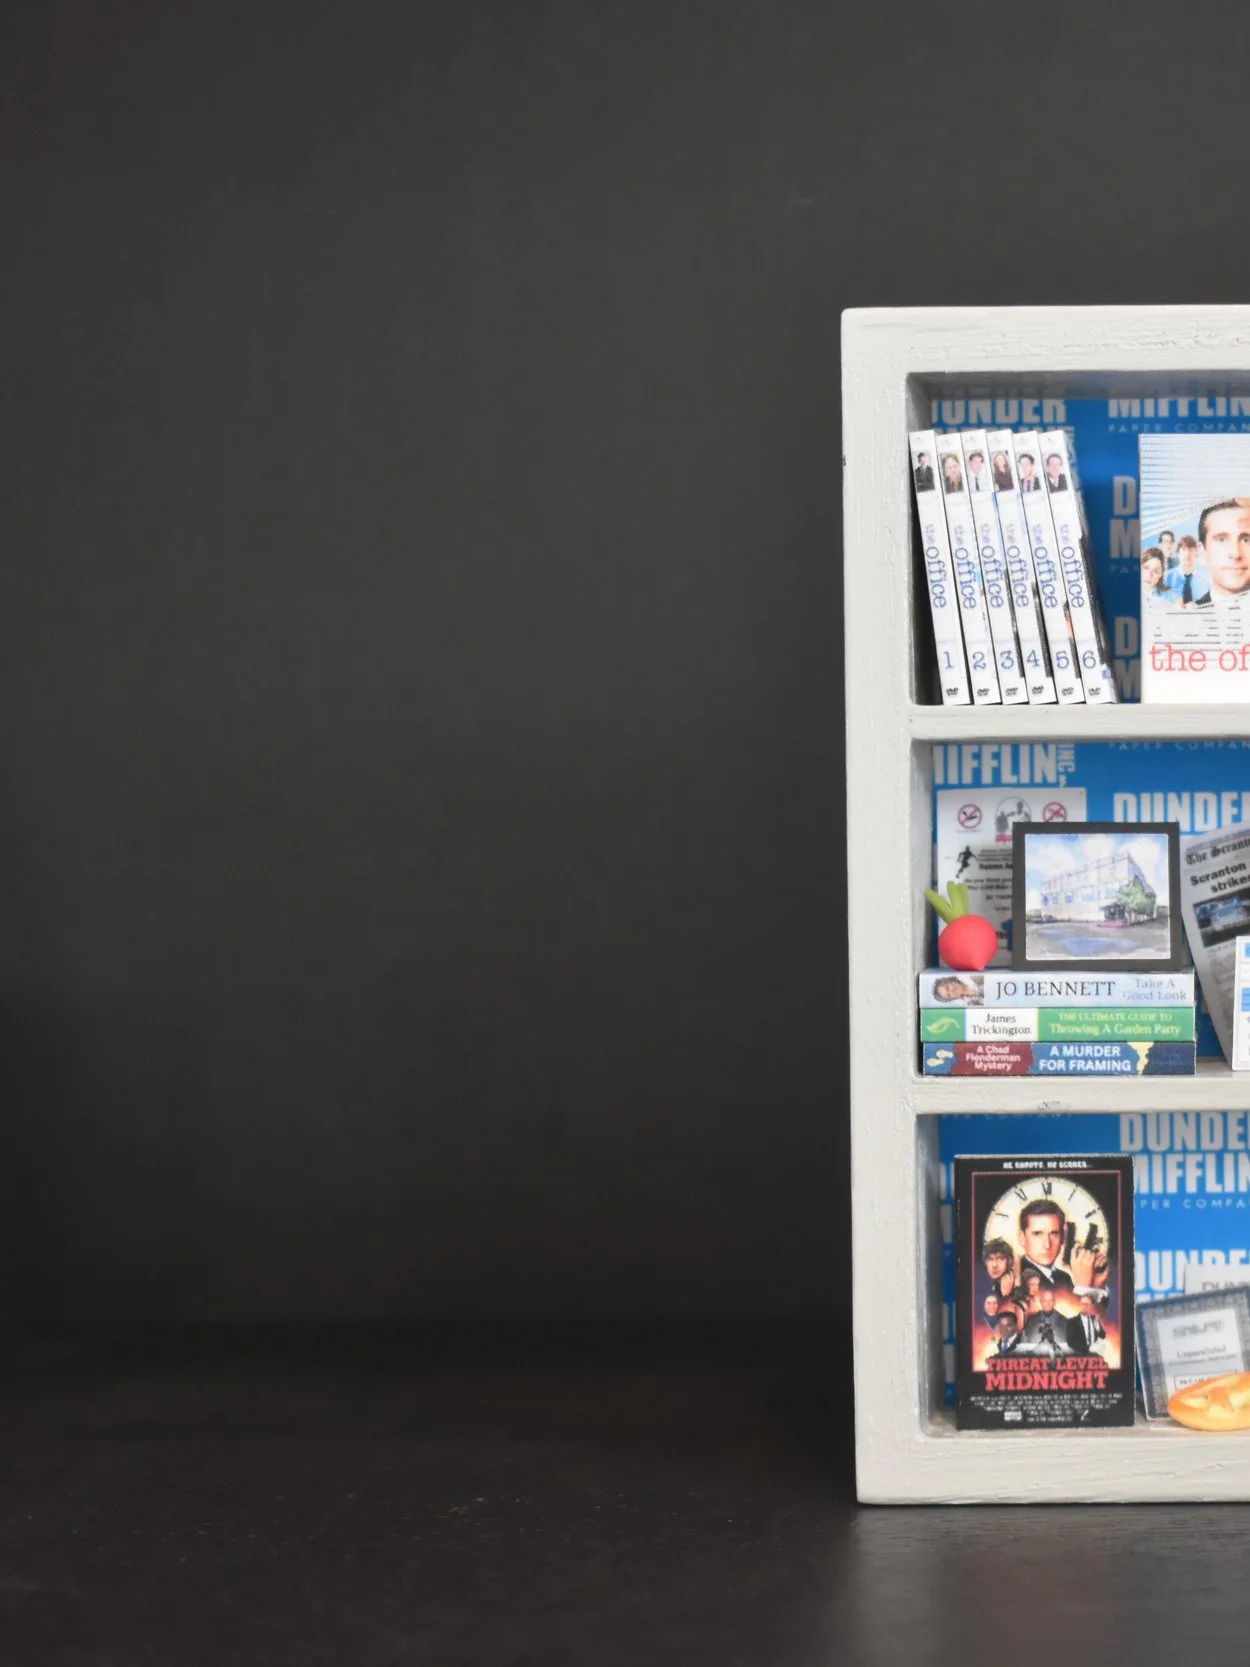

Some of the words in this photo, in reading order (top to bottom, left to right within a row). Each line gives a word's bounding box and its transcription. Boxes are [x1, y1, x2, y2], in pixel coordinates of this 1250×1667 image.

[1108, 423, 1162, 433] PAPER
[926, 546, 947, 609] office
[955, 547, 977, 609] office
[981, 545, 1004, 609] office
[1007, 545, 1029, 608] office
[1034, 546, 1058, 609] office
[1061, 546, 1085, 609] office
[943, 651, 954, 670] 1
[972, 651, 987, 670] 2
[999, 650, 1014, 670] 3
[1026, 649, 1041, 668] 4
[1056, 650, 1070, 670] 5
[1082, 650, 1097, 670] 6
[1150, 643, 1207, 672] the
[1186, 852, 1207, 865] The
[1190, 862, 1246, 886] Scranton
[996, 981, 1017, 1000] JO
[1024, 981, 1116, 997] BENNETT
[1135, 979, 1163, 988] Take
[1122, 991, 1154, 1000] Good
[1157, 990, 1187, 1000] Look
[985, 1013, 1016, 1023] James
[971, 1024, 1031, 1037] Trickington
[1050, 1023, 1100, 1036] Throwing
[1102, 1024, 1111, 1034] A
[1114, 1023, 1151, 1034] Garden
[1154, 1023, 1181, 1036] Party
[985, 1045, 1010, 1053] Chad
[1050, 1046, 1059, 1057] A
[1061, 1046, 1120, 1057] MURDER
[974, 1061, 1012, 1071] Mystery
[1039, 1059, 1066, 1072] FOR
[1069, 1058, 1132, 1072] FRAMING
[1140, 1199, 1171, 1209] PER
[986, 1358, 1049, 1372] THREAT
[1056, 1356, 1109, 1371] LEVEL
[985, 1371, 1108, 1391] MIDNIGHT
